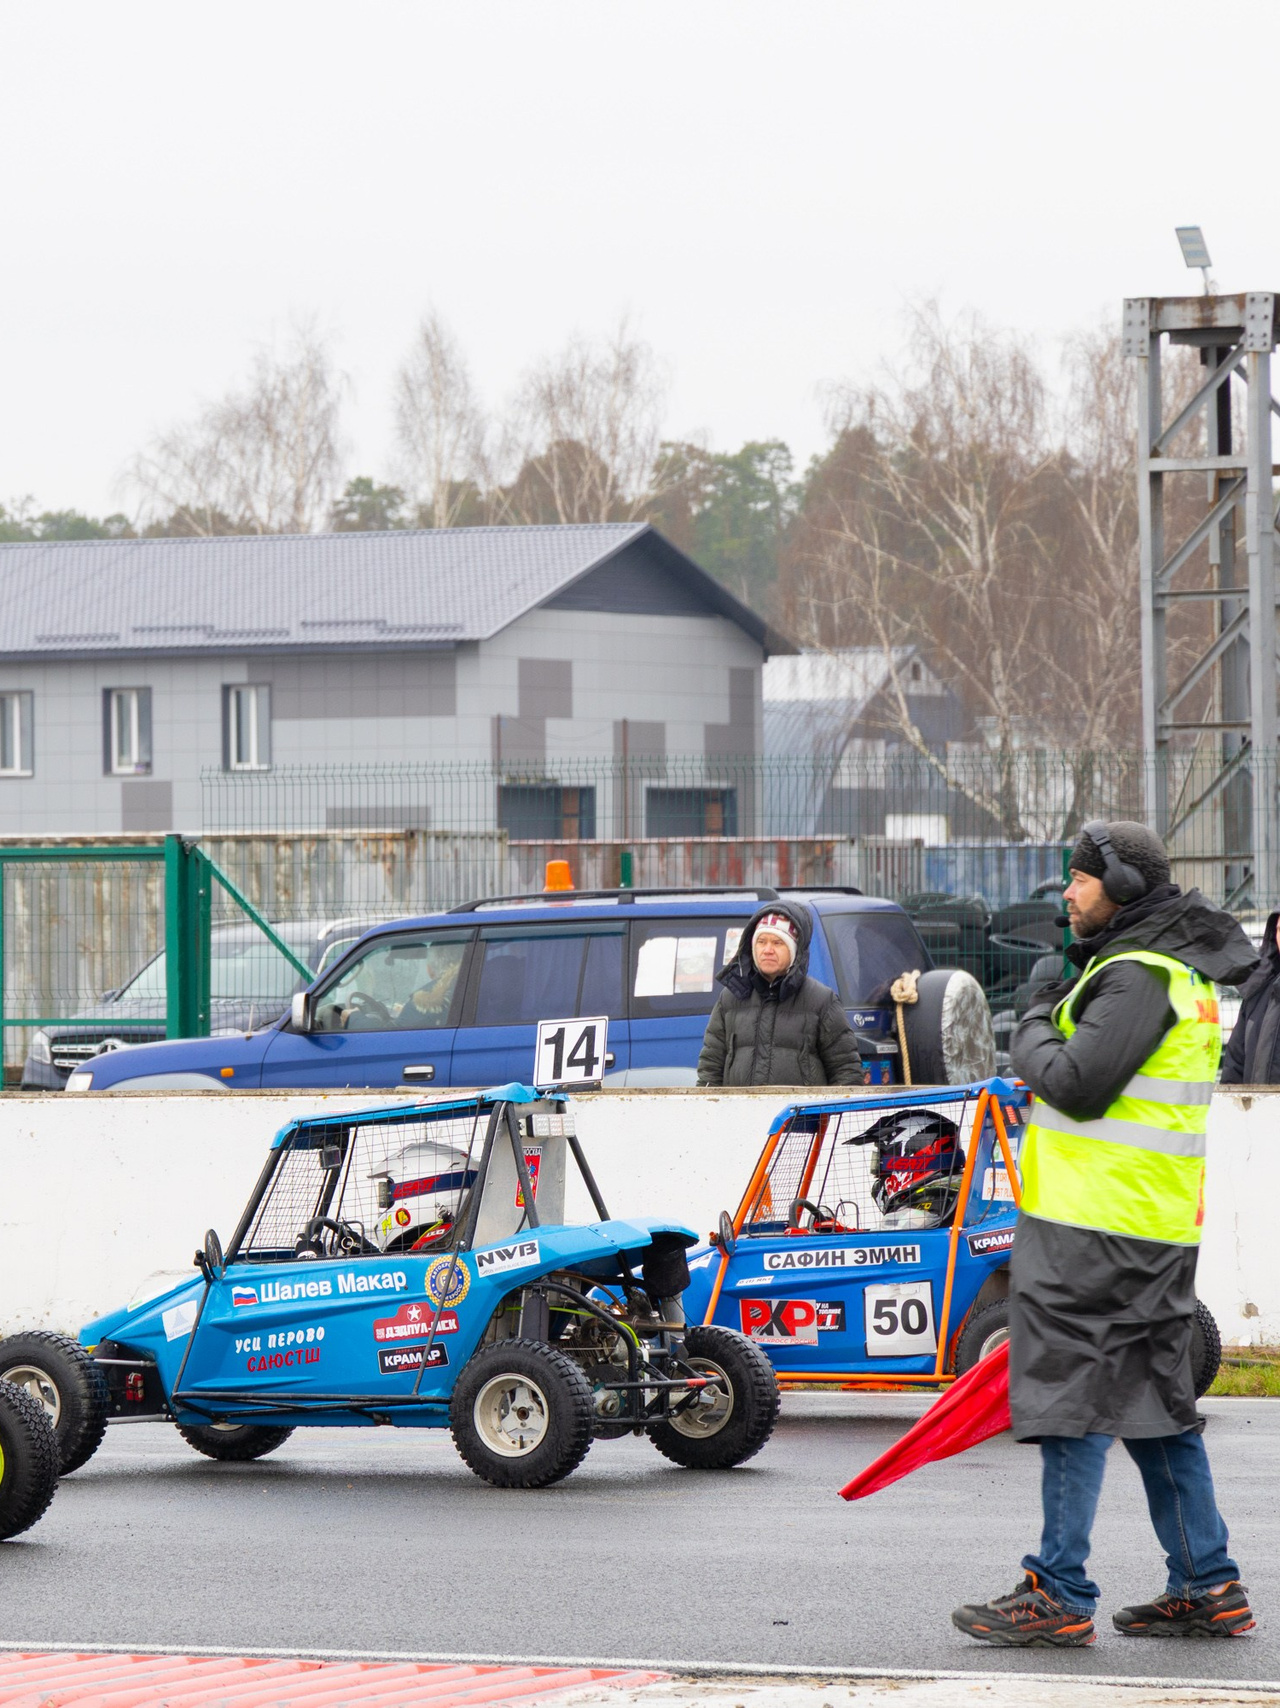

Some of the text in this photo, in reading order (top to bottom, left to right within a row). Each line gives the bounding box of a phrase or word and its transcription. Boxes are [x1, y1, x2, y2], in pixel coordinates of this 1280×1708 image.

[544, 1025, 599, 1080] 14
[973, 1233, 1015, 1249] КРАМА
[477, 1243, 537, 1267] NWB
[768, 1246, 916, 1269] САФИН ЭМИН
[261, 1271, 407, 1302] Шалев Макар
[873, 1298, 928, 1336] 50
[268, 1326, 325, 1349] ПЕРОВО
[247, 1347, 320, 1373] СДЮСТШ
